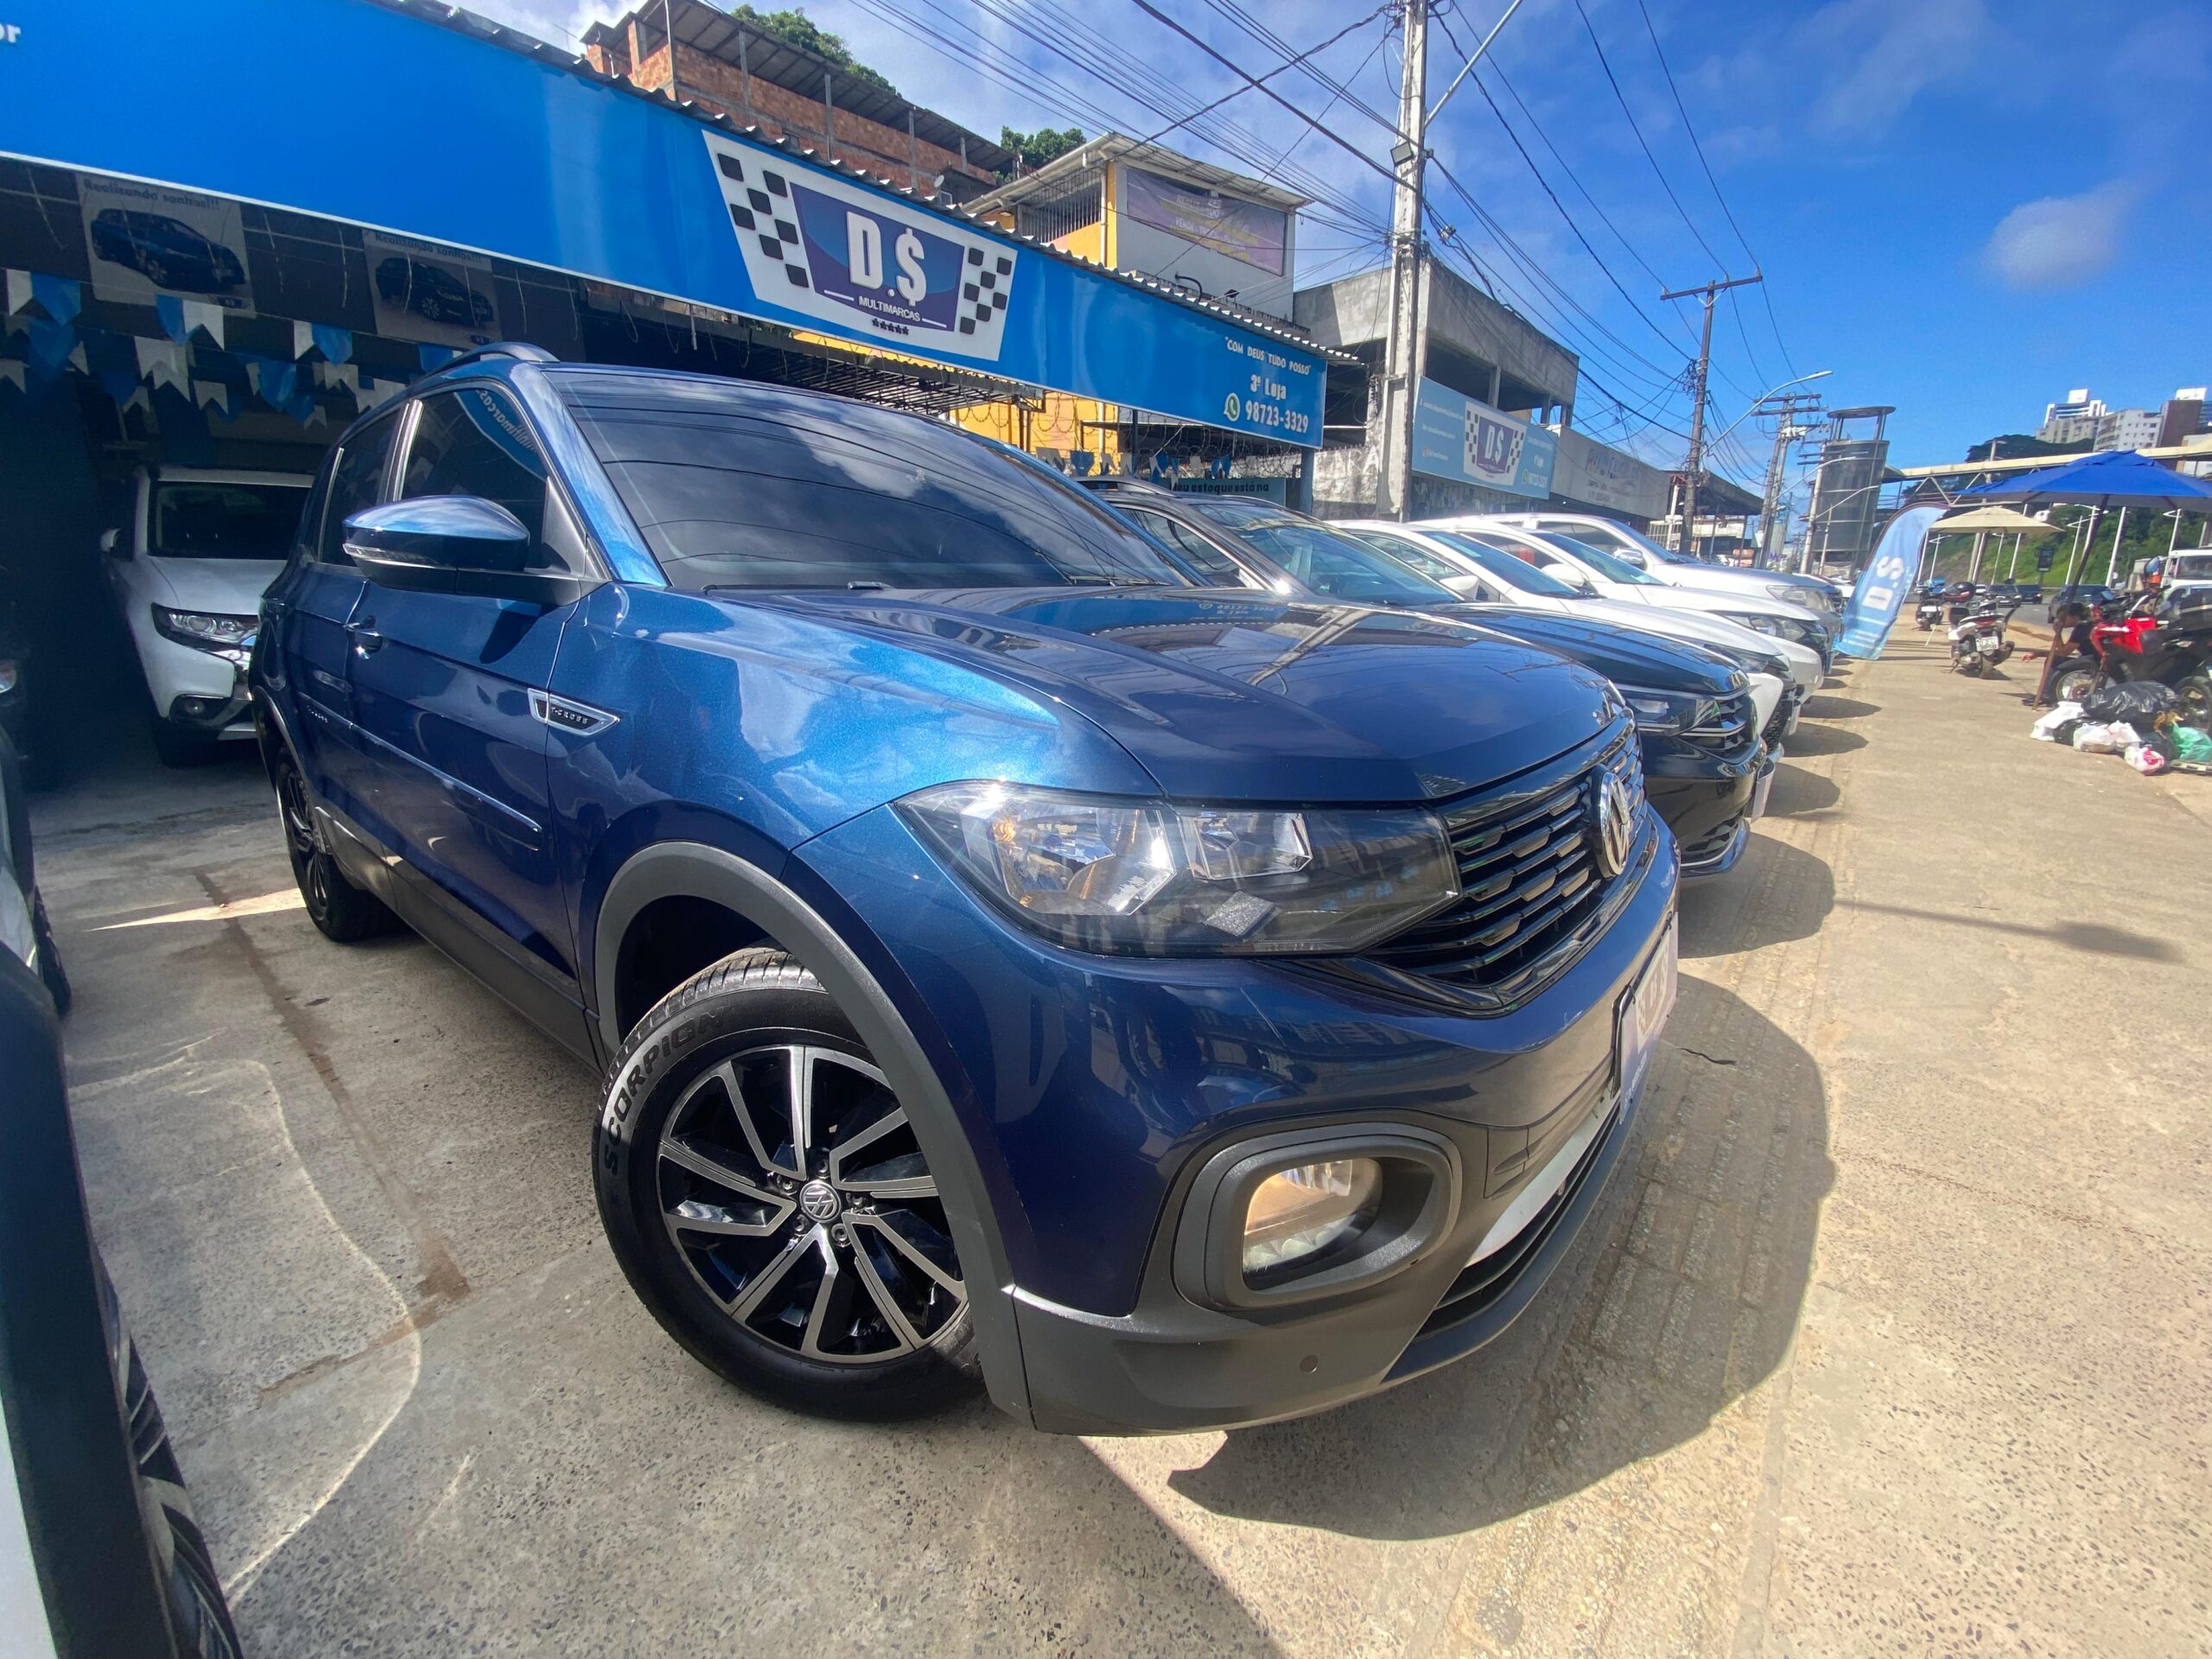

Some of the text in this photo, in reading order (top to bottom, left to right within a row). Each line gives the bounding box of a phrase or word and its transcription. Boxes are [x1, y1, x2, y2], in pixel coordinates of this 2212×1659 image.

[84, 178, 157, 200] Realizando
[858, 296, 920, 322] MULTIMARCAS
[1247, 346, 1264, 361] DEUS
[1268, 353, 1286, 368] TUDO
[1265, 378, 1287, 400] Loja
[1245, 400, 1309, 433] 98723-3329
[1257, 483, 1269, 493] na
[605, 1010, 725, 1176] SCORPION
